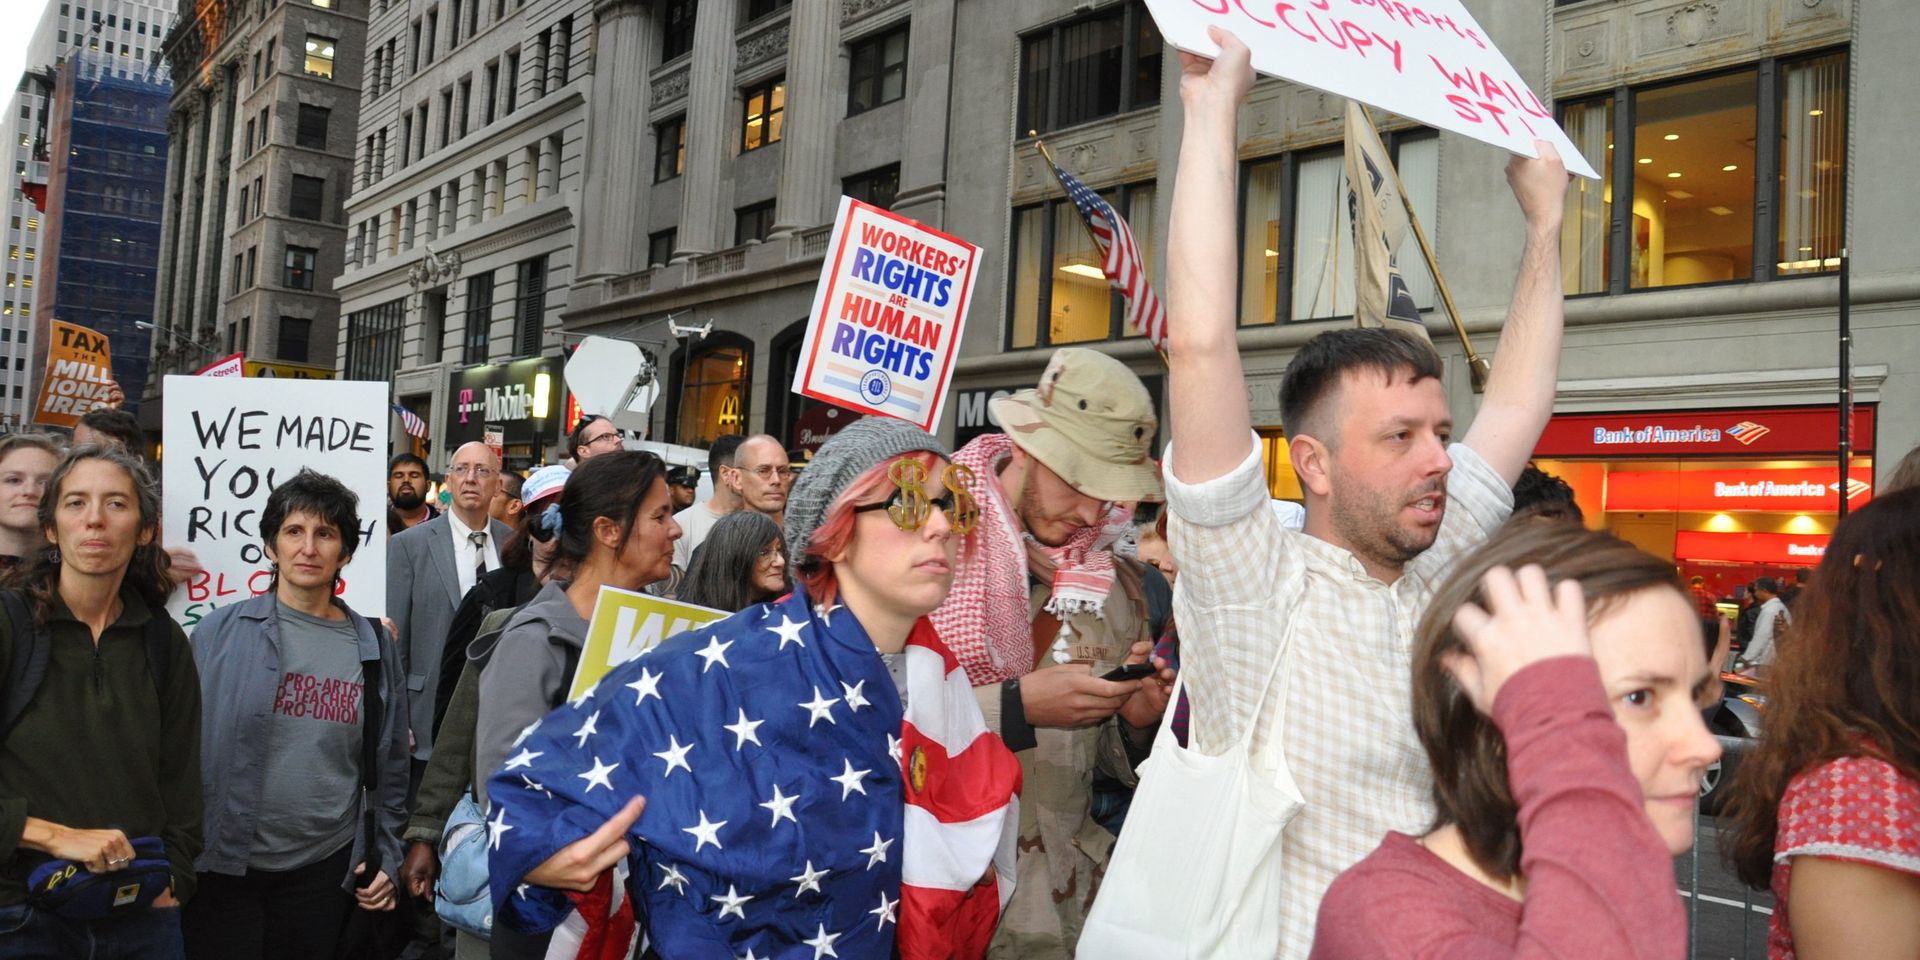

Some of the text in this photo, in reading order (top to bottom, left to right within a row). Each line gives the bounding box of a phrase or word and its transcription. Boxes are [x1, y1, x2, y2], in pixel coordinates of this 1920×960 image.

[1352, 0, 1486, 50] pports
[861, 222, 967, 277] WORKERS'
[851, 247, 953, 308] RIGHTS
[888, 293, 909, 309] ARE
[839, 292, 943, 351] HUMAN
[59, 326, 106, 357] TAX
[831, 322, 934, 382] RIGHTS
[73, 352, 97, 362] THE
[52, 359, 112, 385] MILL
[192, 406, 375, 453] WE MADE
[1593, 425, 1721, 444] Bank of America
[1714, 480, 1826, 497] Bank of America
[187, 506, 256, 542] RIC
[1788, 544, 1817, 557] Bank
[273, 697, 359, 725] PRO-UNION
[276, 685, 357, 711] O-TEACHER
